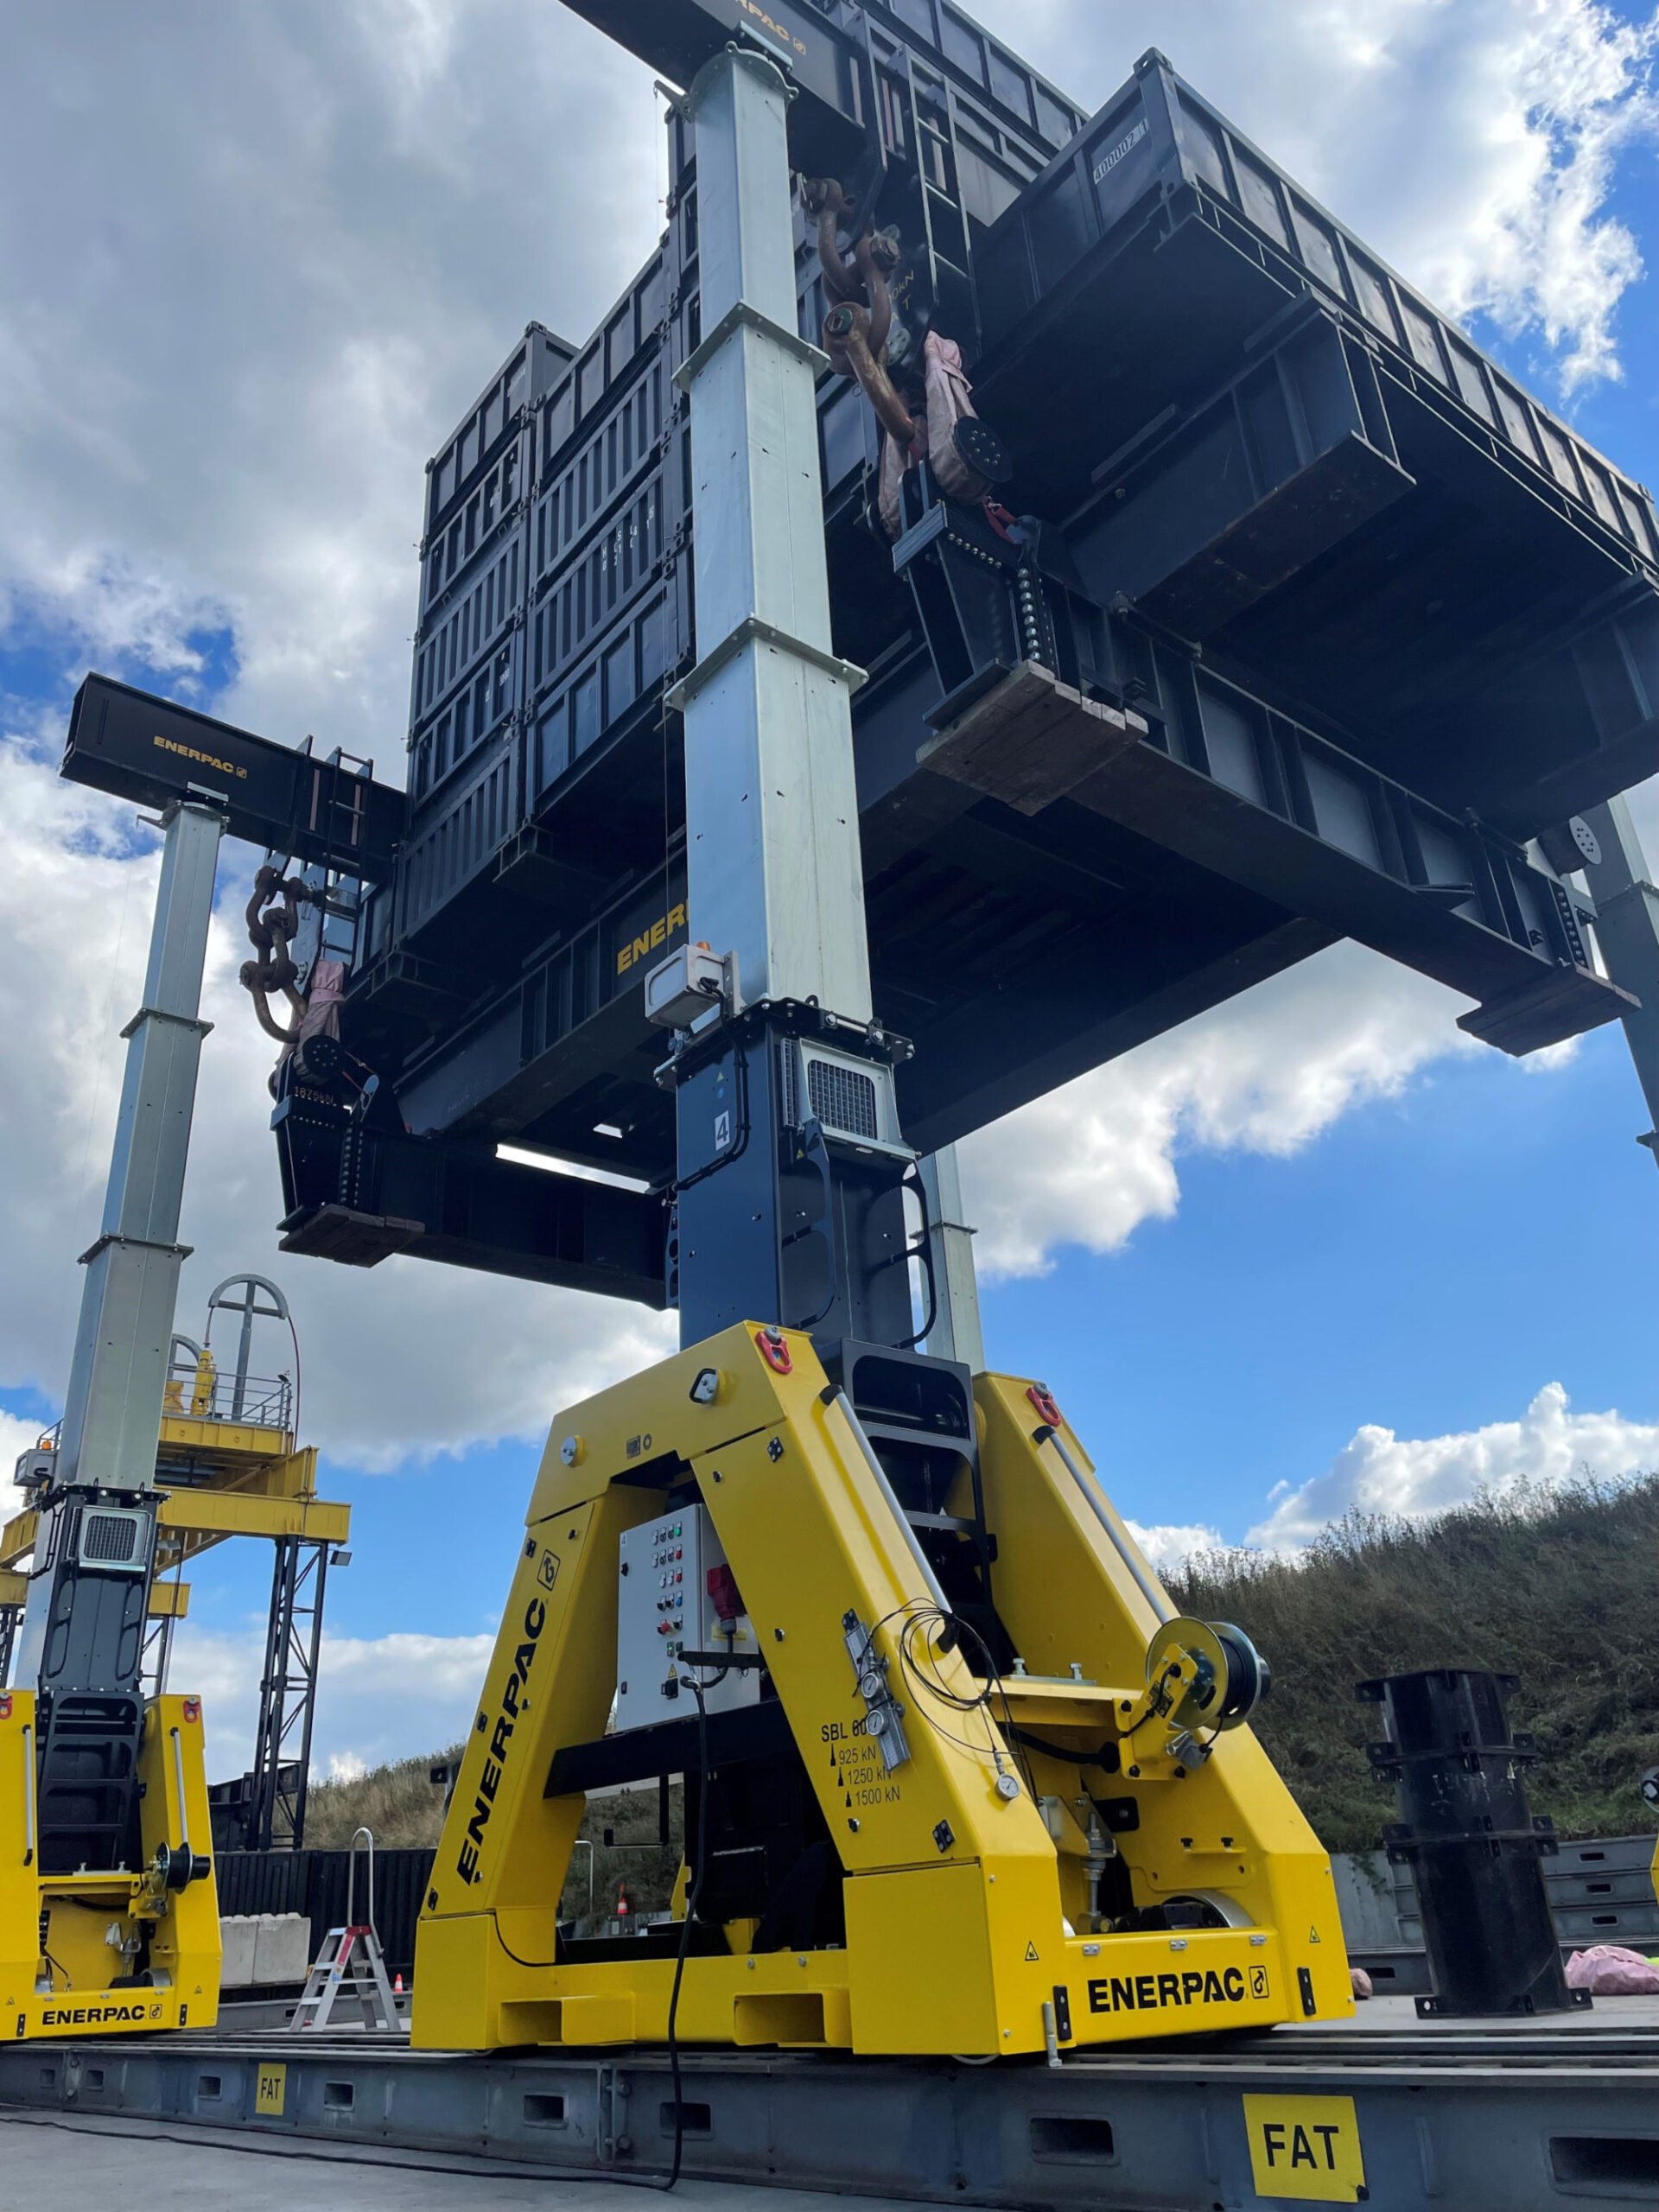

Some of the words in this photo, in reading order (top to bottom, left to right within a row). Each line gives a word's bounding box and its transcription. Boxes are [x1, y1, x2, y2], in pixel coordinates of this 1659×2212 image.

[153, 735, 234, 773] ENERPAC
[617, 899, 689, 975] ENER
[716, 1116, 728, 1142] 4
[456, 1597, 546, 1885] ENERPAC
[821, 1722, 848, 1742] SBL
[852, 1718, 868, 1737] 60
[839, 1747, 859, 1765] 925
[861, 1745, 876, 1761] kN
[848, 1767, 874, 1784] 1250
[855, 1788, 881, 1806] 1500
[885, 1785, 900, 1802] kN
[1087, 1967, 1244, 2013] ENERPAC
[42, 2005, 145, 2025] ENERPAC
[261, 2077, 281, 2100] FAT
[1262, 2123, 1339, 2170] FAT
